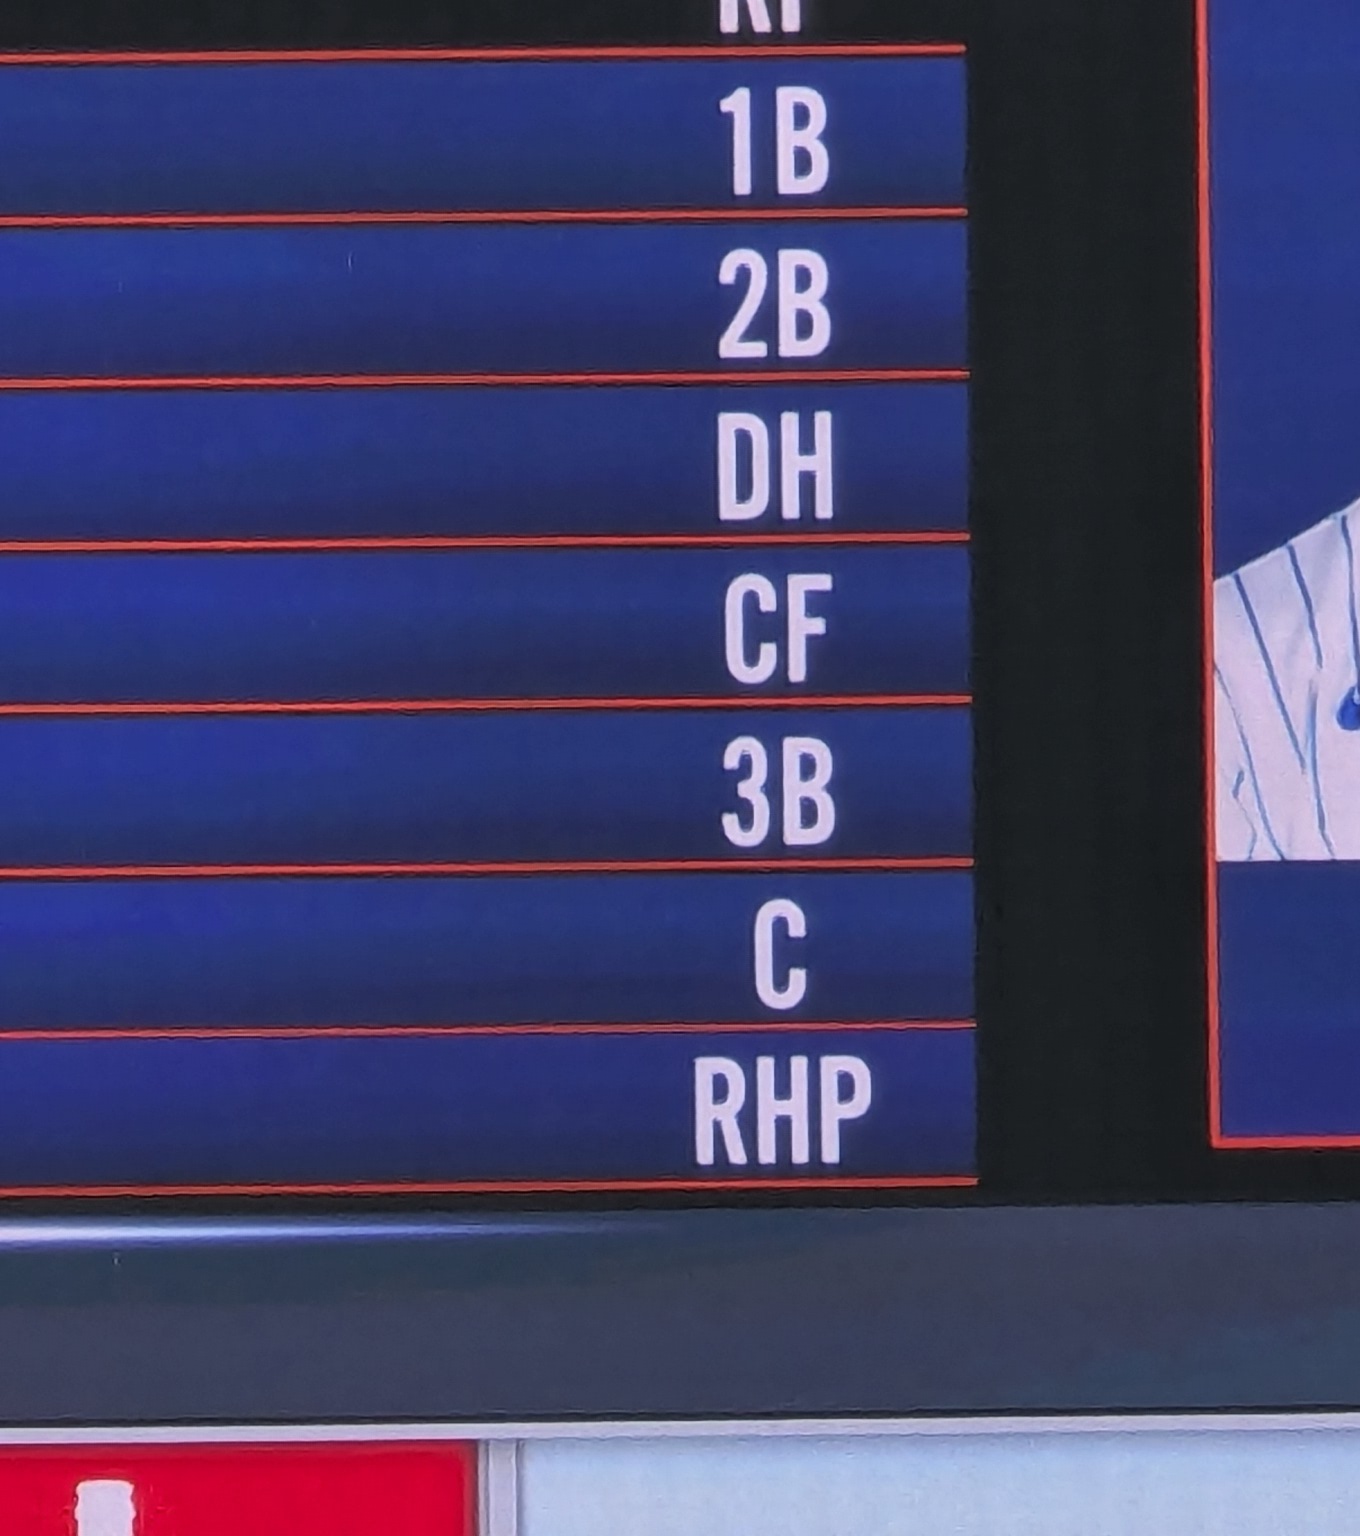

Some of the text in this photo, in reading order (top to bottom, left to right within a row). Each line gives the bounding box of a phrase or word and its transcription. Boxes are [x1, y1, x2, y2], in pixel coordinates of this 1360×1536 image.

[719, 85, 830, 196] 1B
[718, 248, 832, 359] 2B
[717, 410, 834, 521] DH
[724, 572, 833, 684] CF
[721, 736, 836, 847] 3B
[754, 898, 807, 1010] C
[694, 1055, 872, 1166] RHP
